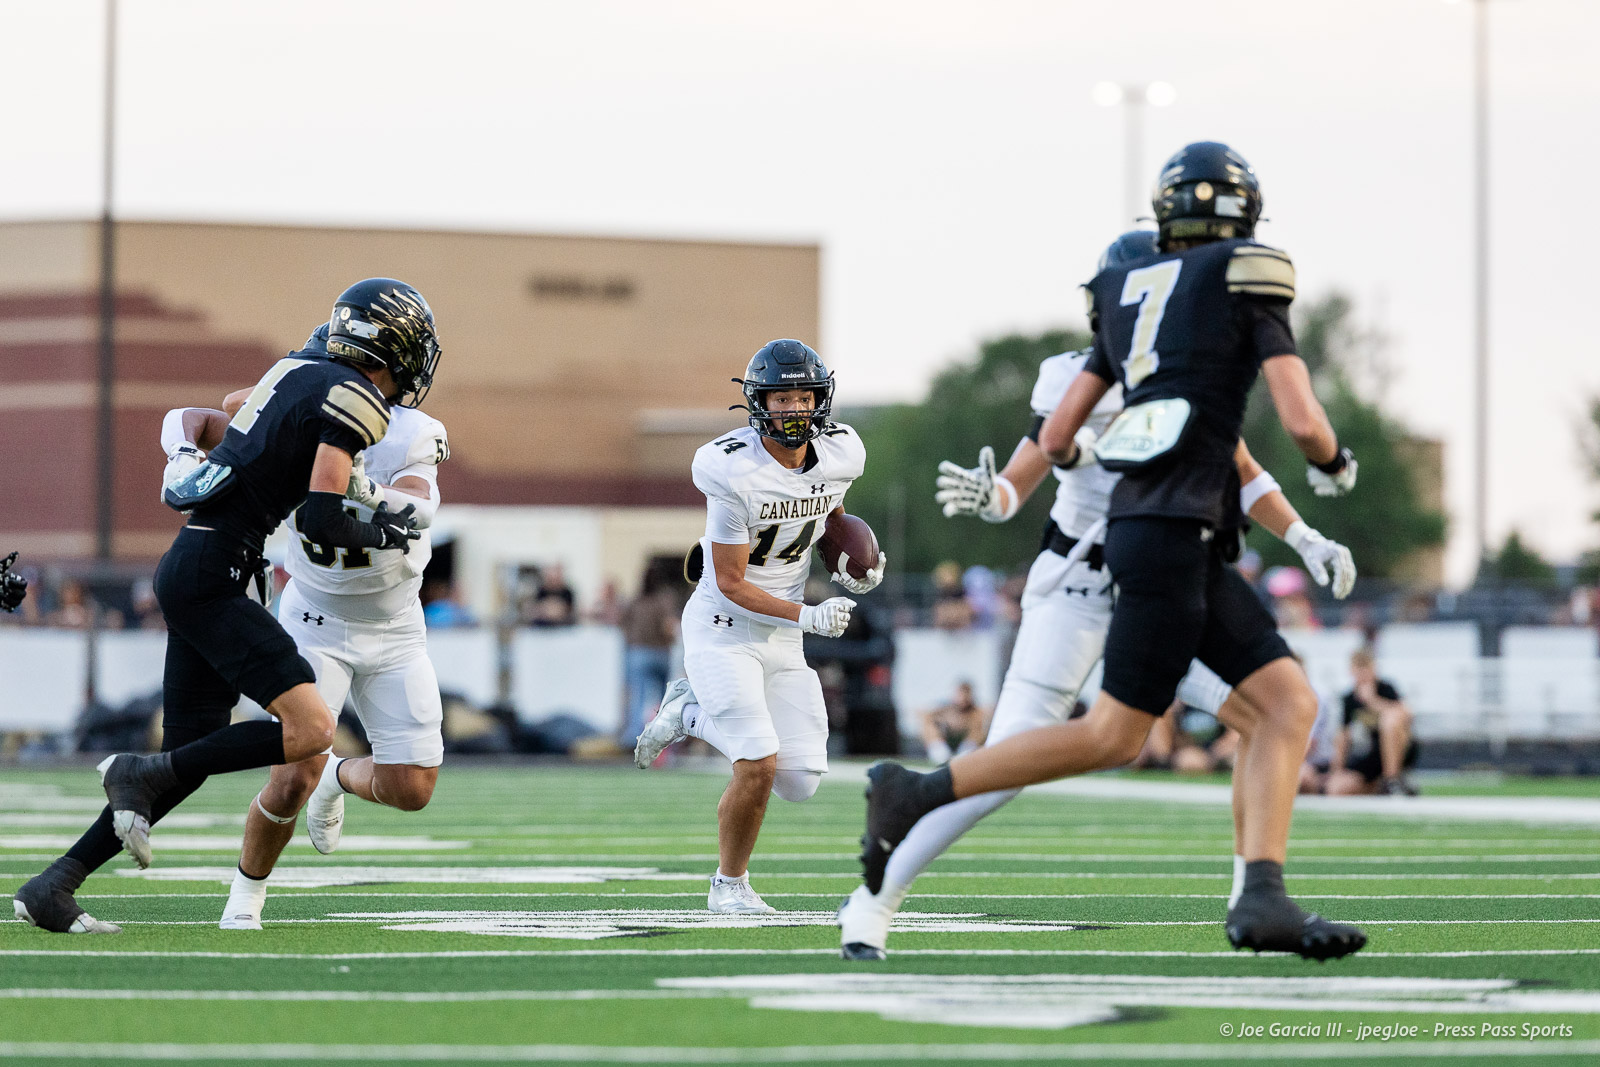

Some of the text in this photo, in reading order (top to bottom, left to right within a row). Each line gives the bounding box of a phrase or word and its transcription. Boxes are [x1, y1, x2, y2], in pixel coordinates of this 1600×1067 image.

[1120, 258, 1183, 390] 7
[713, 437, 749, 455] 14
[759, 496, 833, 520] CANADIAN
[748, 519, 818, 567] 14
